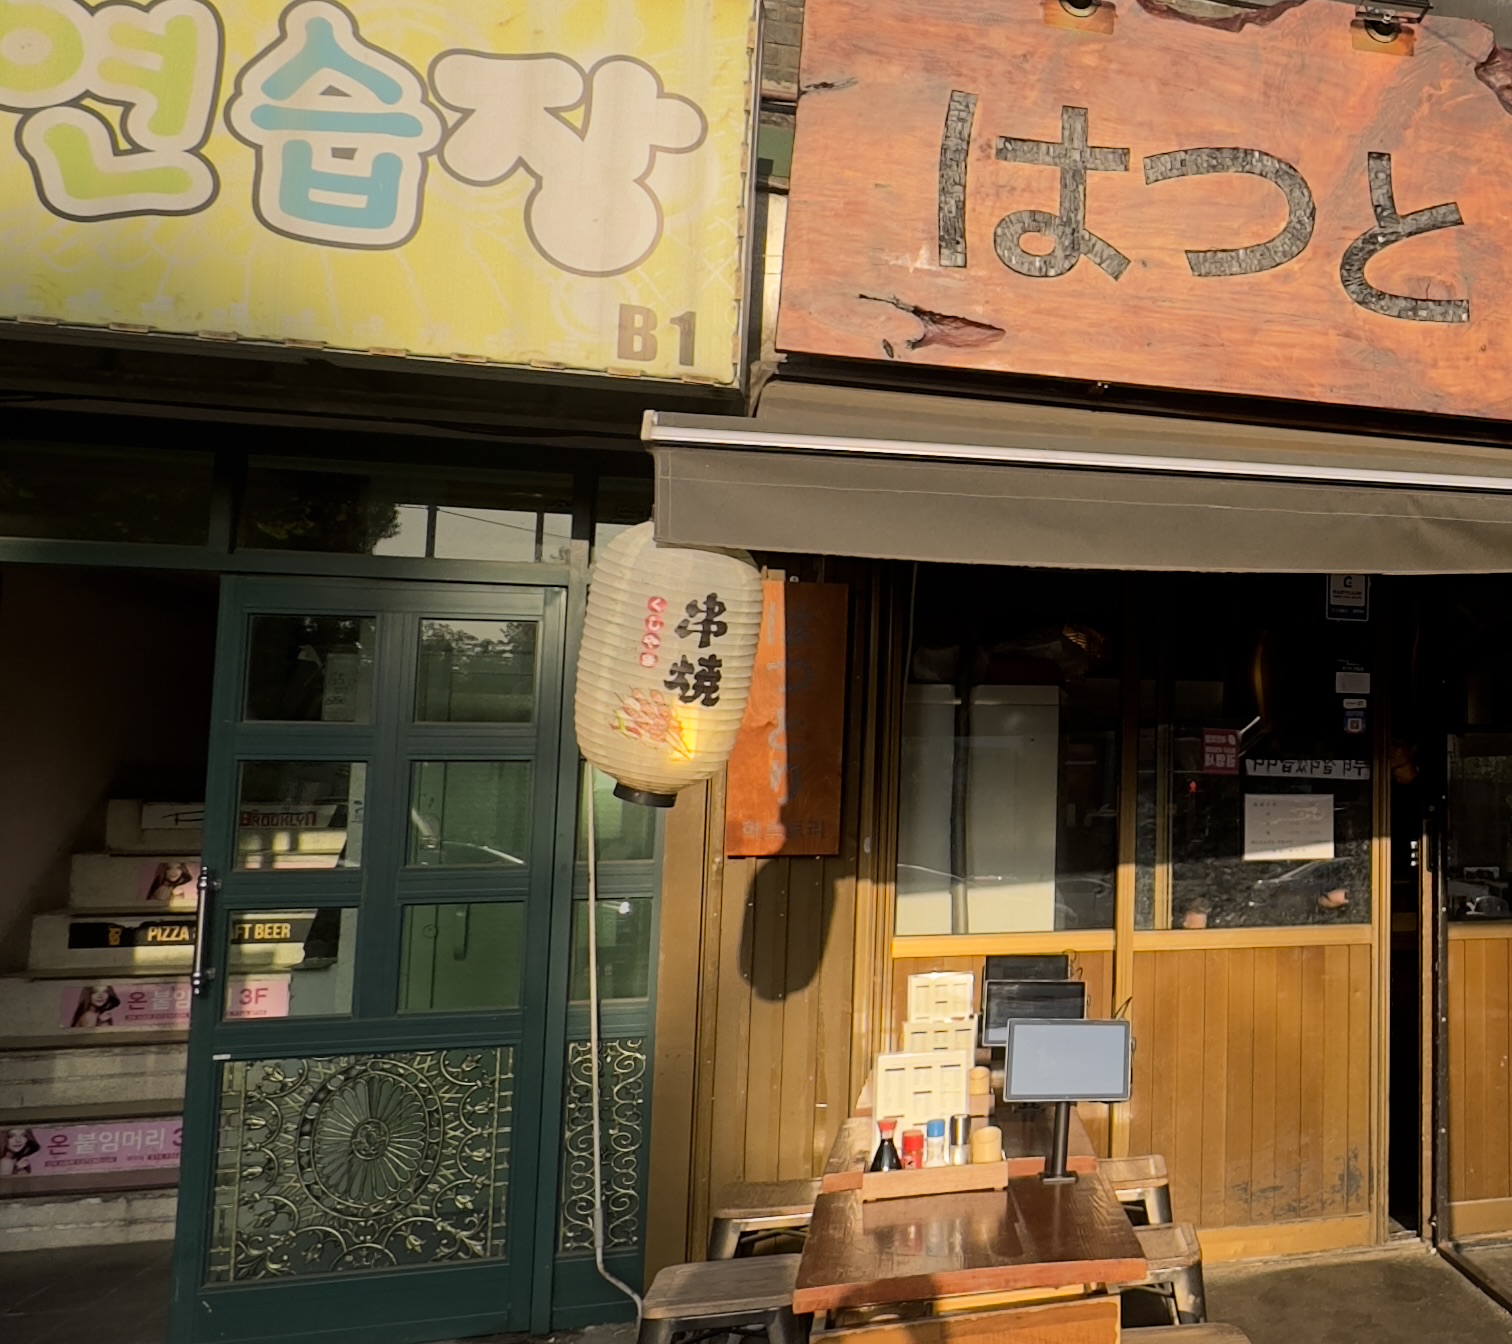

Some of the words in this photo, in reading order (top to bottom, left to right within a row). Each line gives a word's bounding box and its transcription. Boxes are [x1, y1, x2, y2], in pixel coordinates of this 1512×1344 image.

[616, 302, 697, 368] B1
[147, 926, 190, 942] PIZZA
[253, 922, 292, 940] BEER
[239, 987, 269, 1005] 3F
[74, 1127, 166, 1155] 붙임머리
